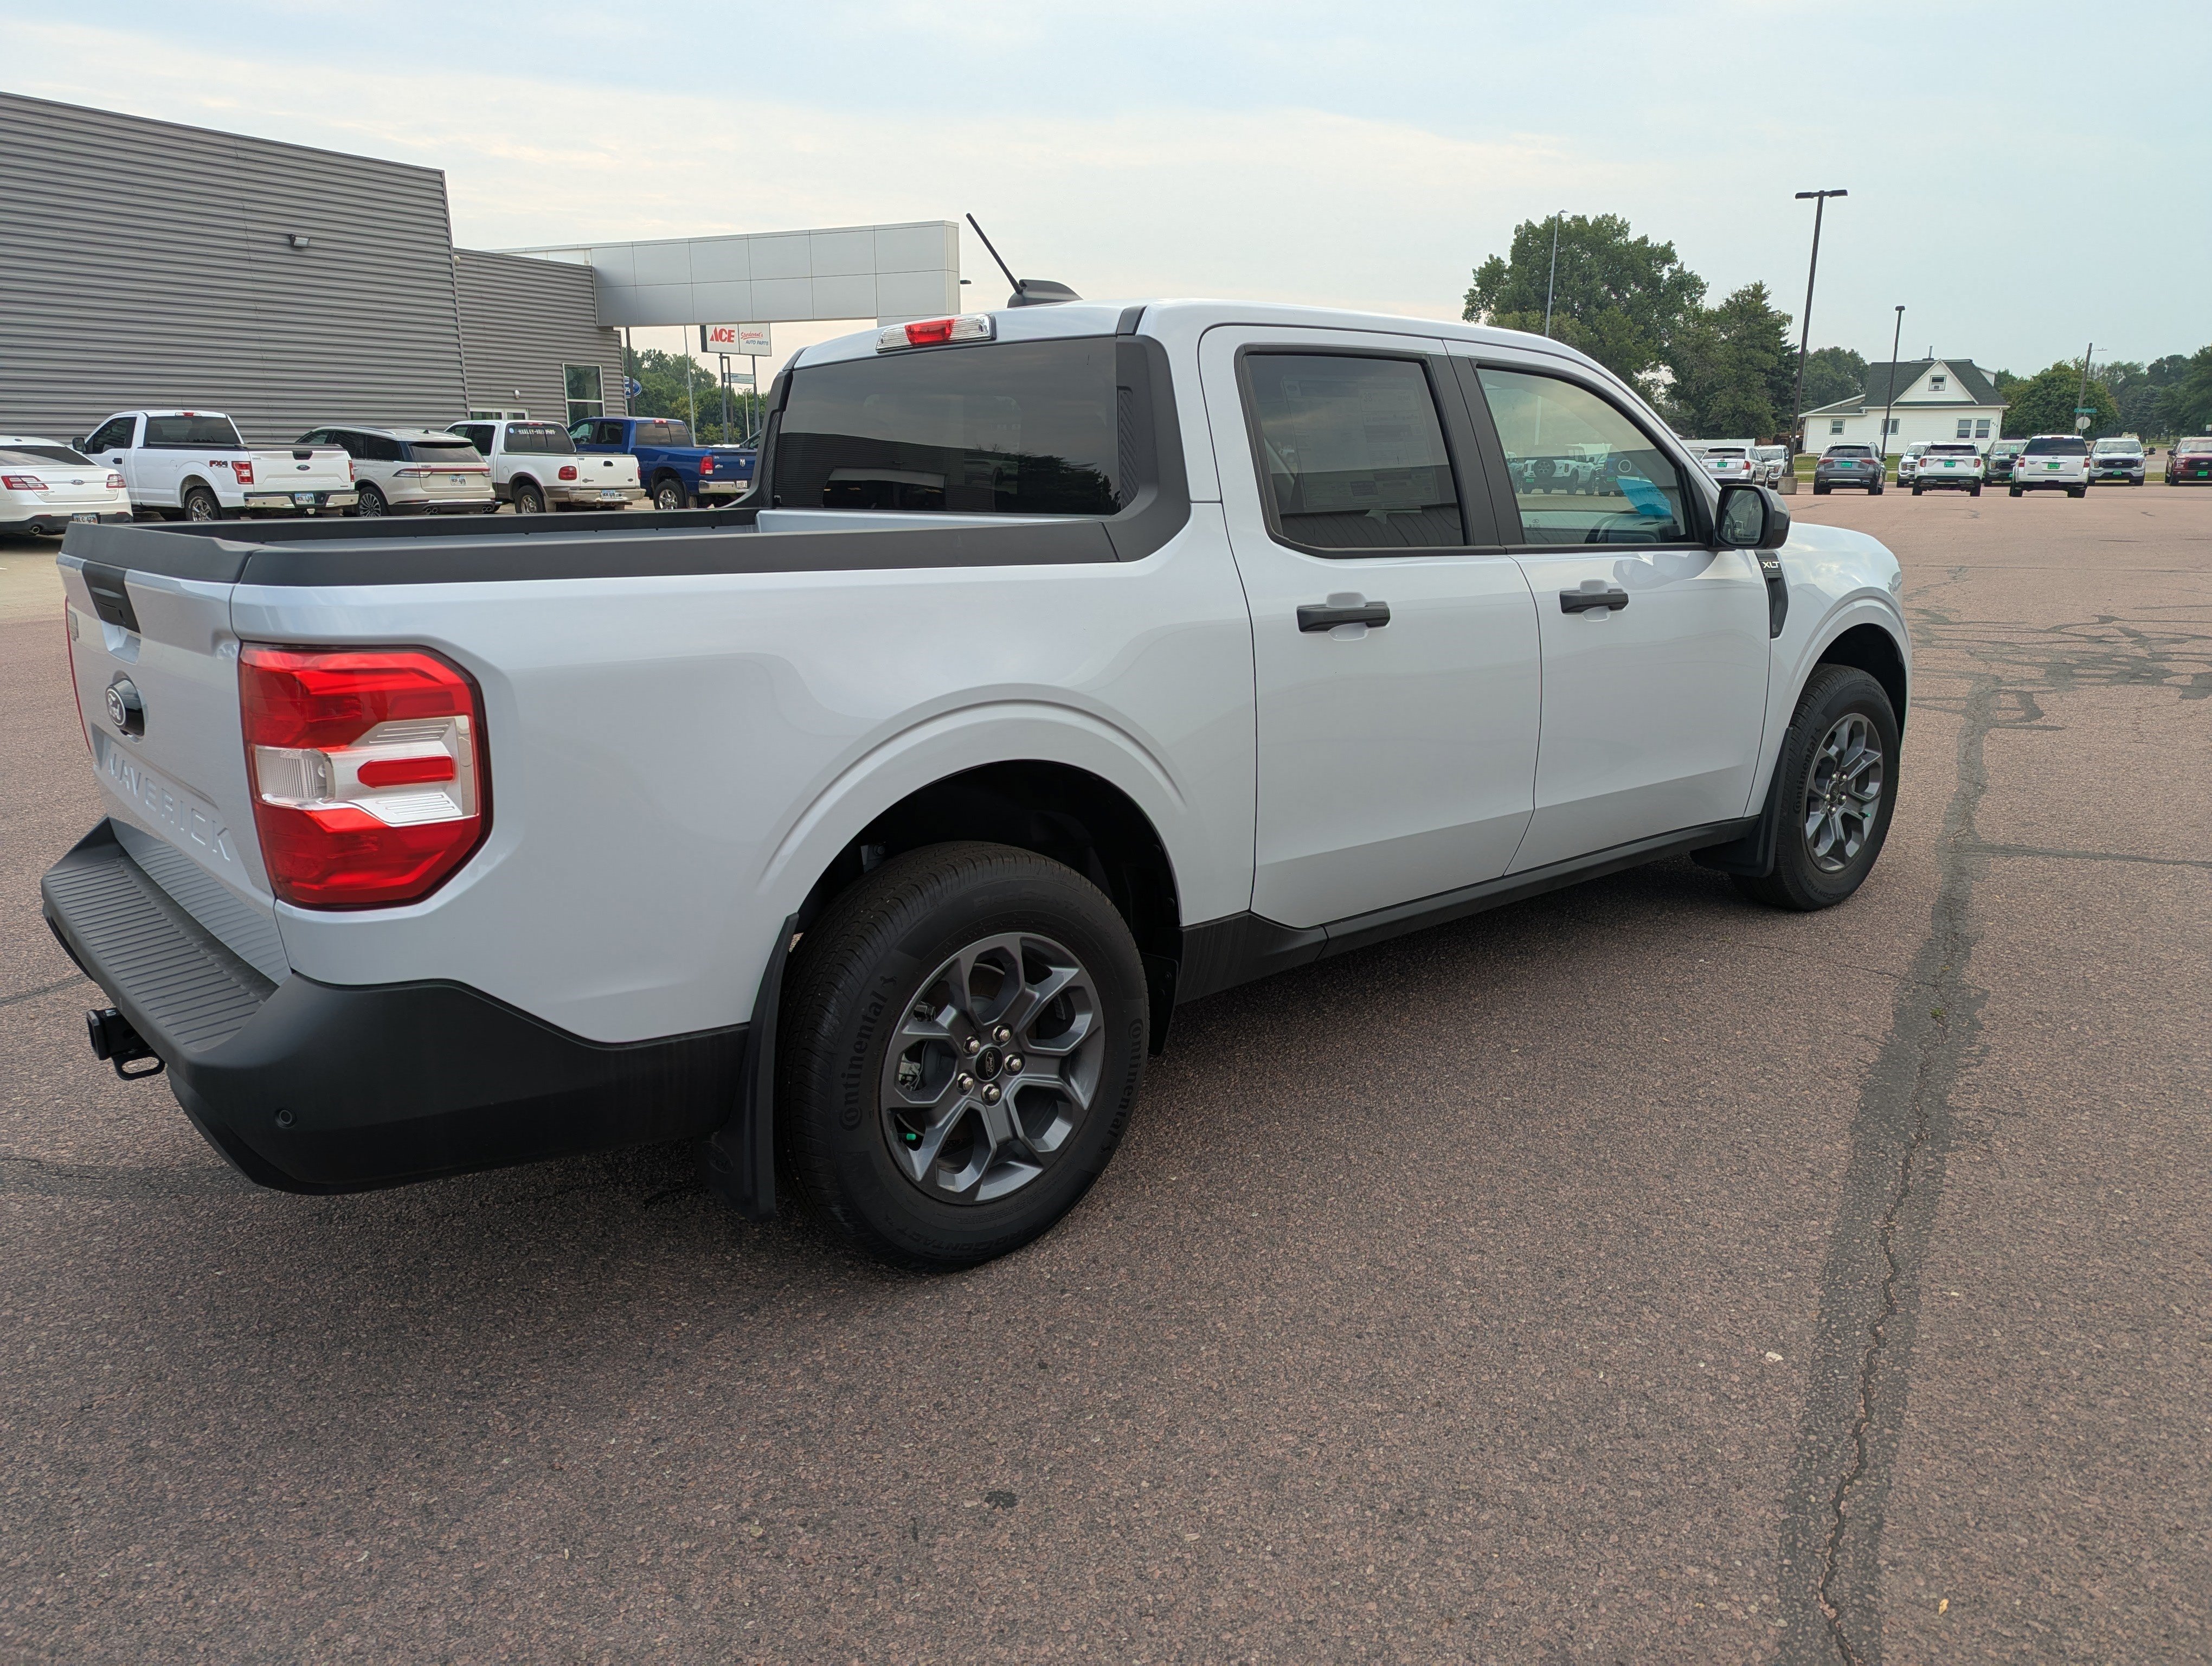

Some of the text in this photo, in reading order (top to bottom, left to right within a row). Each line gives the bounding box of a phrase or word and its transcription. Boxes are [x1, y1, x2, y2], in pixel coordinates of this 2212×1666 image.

[710, 326, 735, 343] ACE
[209, 460, 228, 468] FX4
[1761, 561, 1780, 569] XLT
[1792, 735, 1818, 814] Continental
[838, 990, 888, 1131] Continental
[1107, 1017, 1144, 1138] Continental
